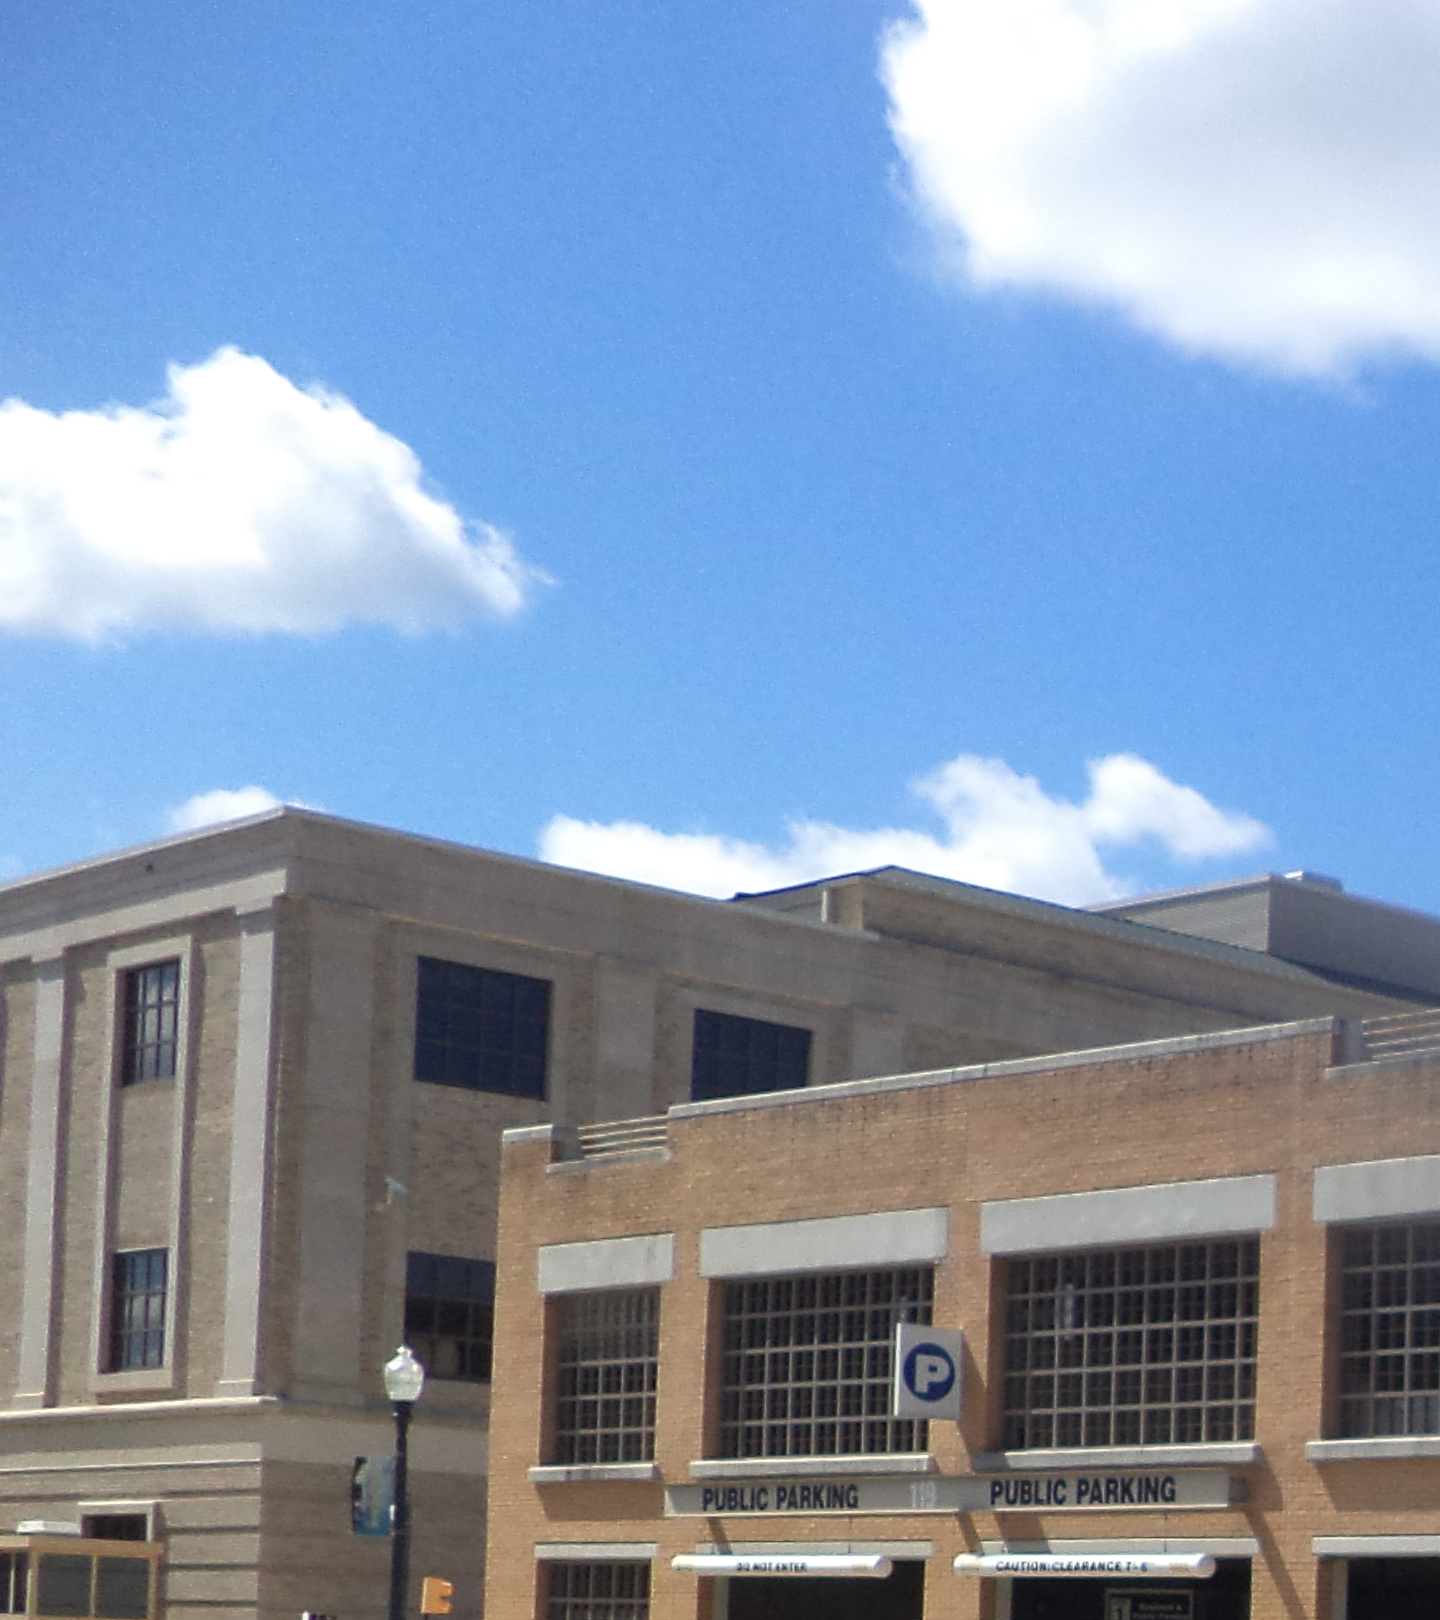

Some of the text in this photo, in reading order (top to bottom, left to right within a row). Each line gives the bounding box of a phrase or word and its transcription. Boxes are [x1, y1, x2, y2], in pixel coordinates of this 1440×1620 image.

[915, 1354, 951, 1393] P
[702, 1484, 860, 1511] PUBLIC PARKING
[989, 1476, 1176, 1505] PUBLIC PARKING
[775, 1562, 808, 1573] ENTER
